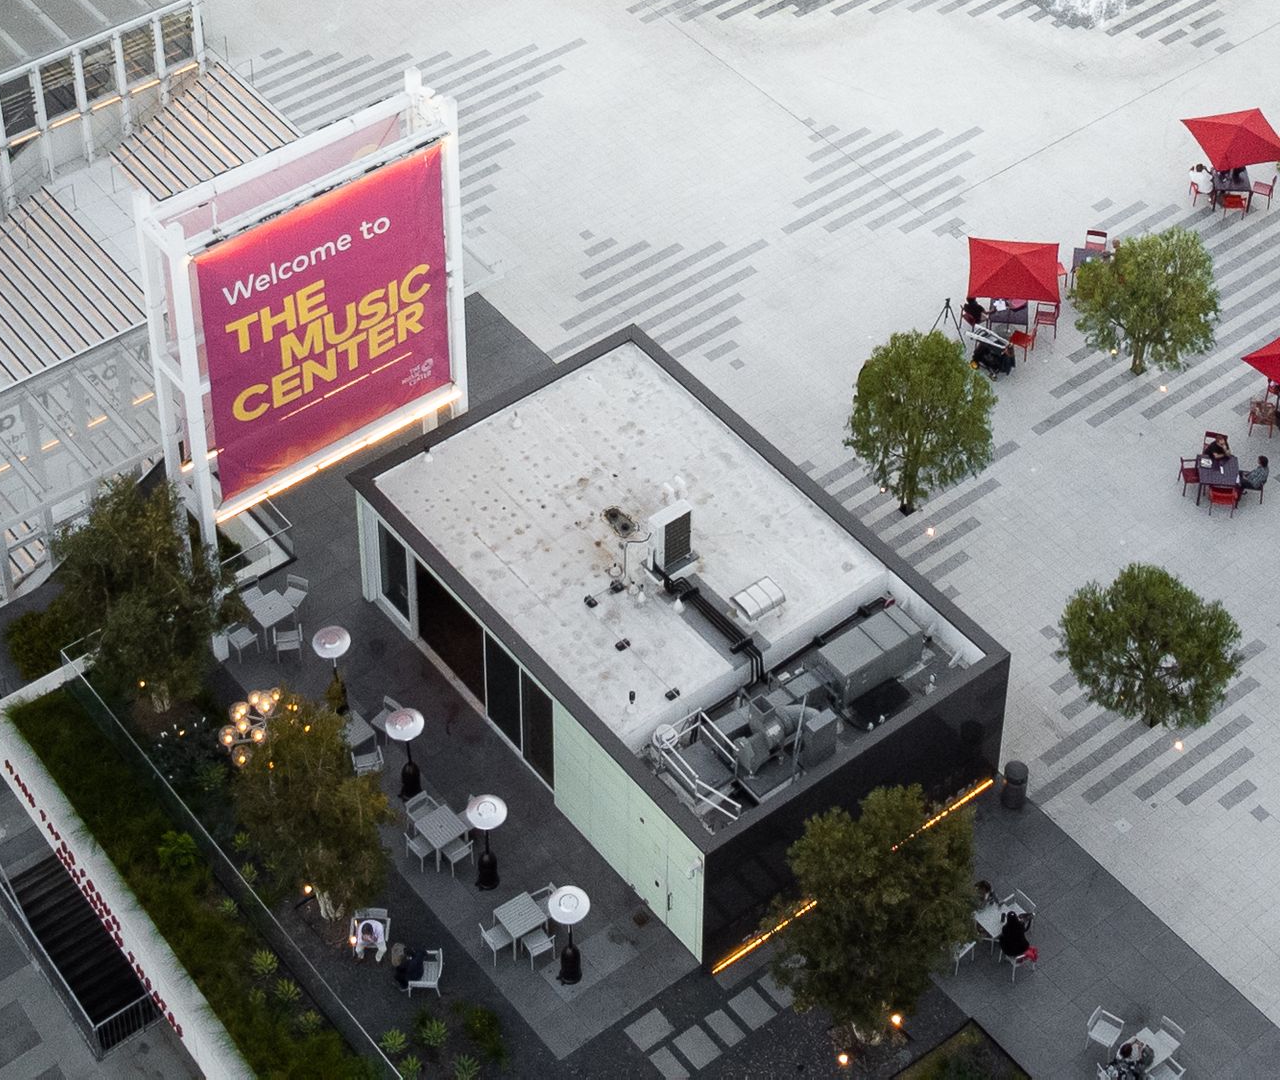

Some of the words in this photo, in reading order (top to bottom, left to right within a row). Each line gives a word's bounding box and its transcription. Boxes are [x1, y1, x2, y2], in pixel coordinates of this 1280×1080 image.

[222, 233, 352, 306] Welcome
[360, 216, 392, 240] to
[225, 279, 328, 354] THE
[232, 303, 425, 421] CENTER
[280, 263, 432, 370] MUSIC
